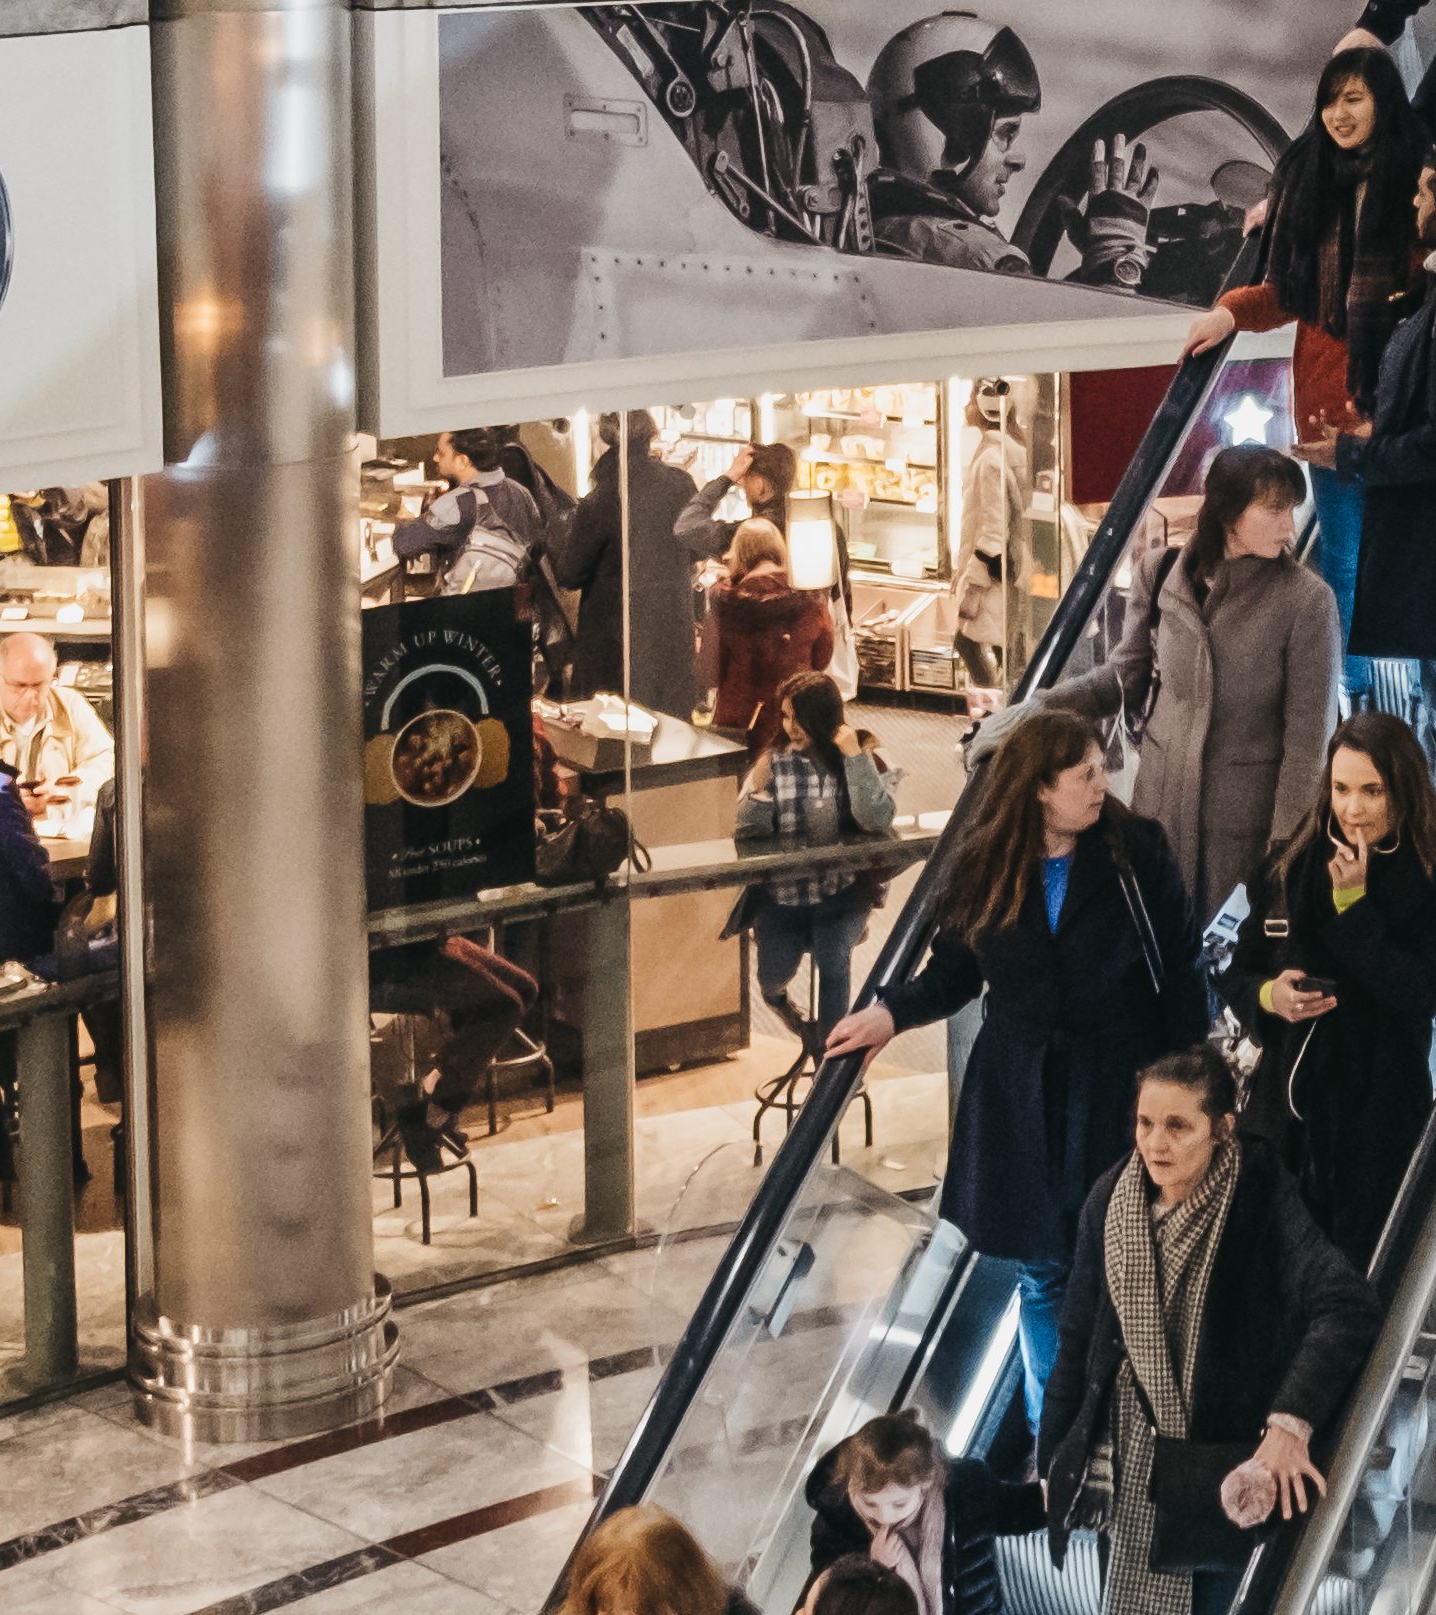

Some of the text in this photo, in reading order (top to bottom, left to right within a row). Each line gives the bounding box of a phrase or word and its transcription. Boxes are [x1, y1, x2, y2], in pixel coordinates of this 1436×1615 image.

[365, 629, 501, 695] WARM UP WINTER
[428, 836, 473, 853] SOUPS
